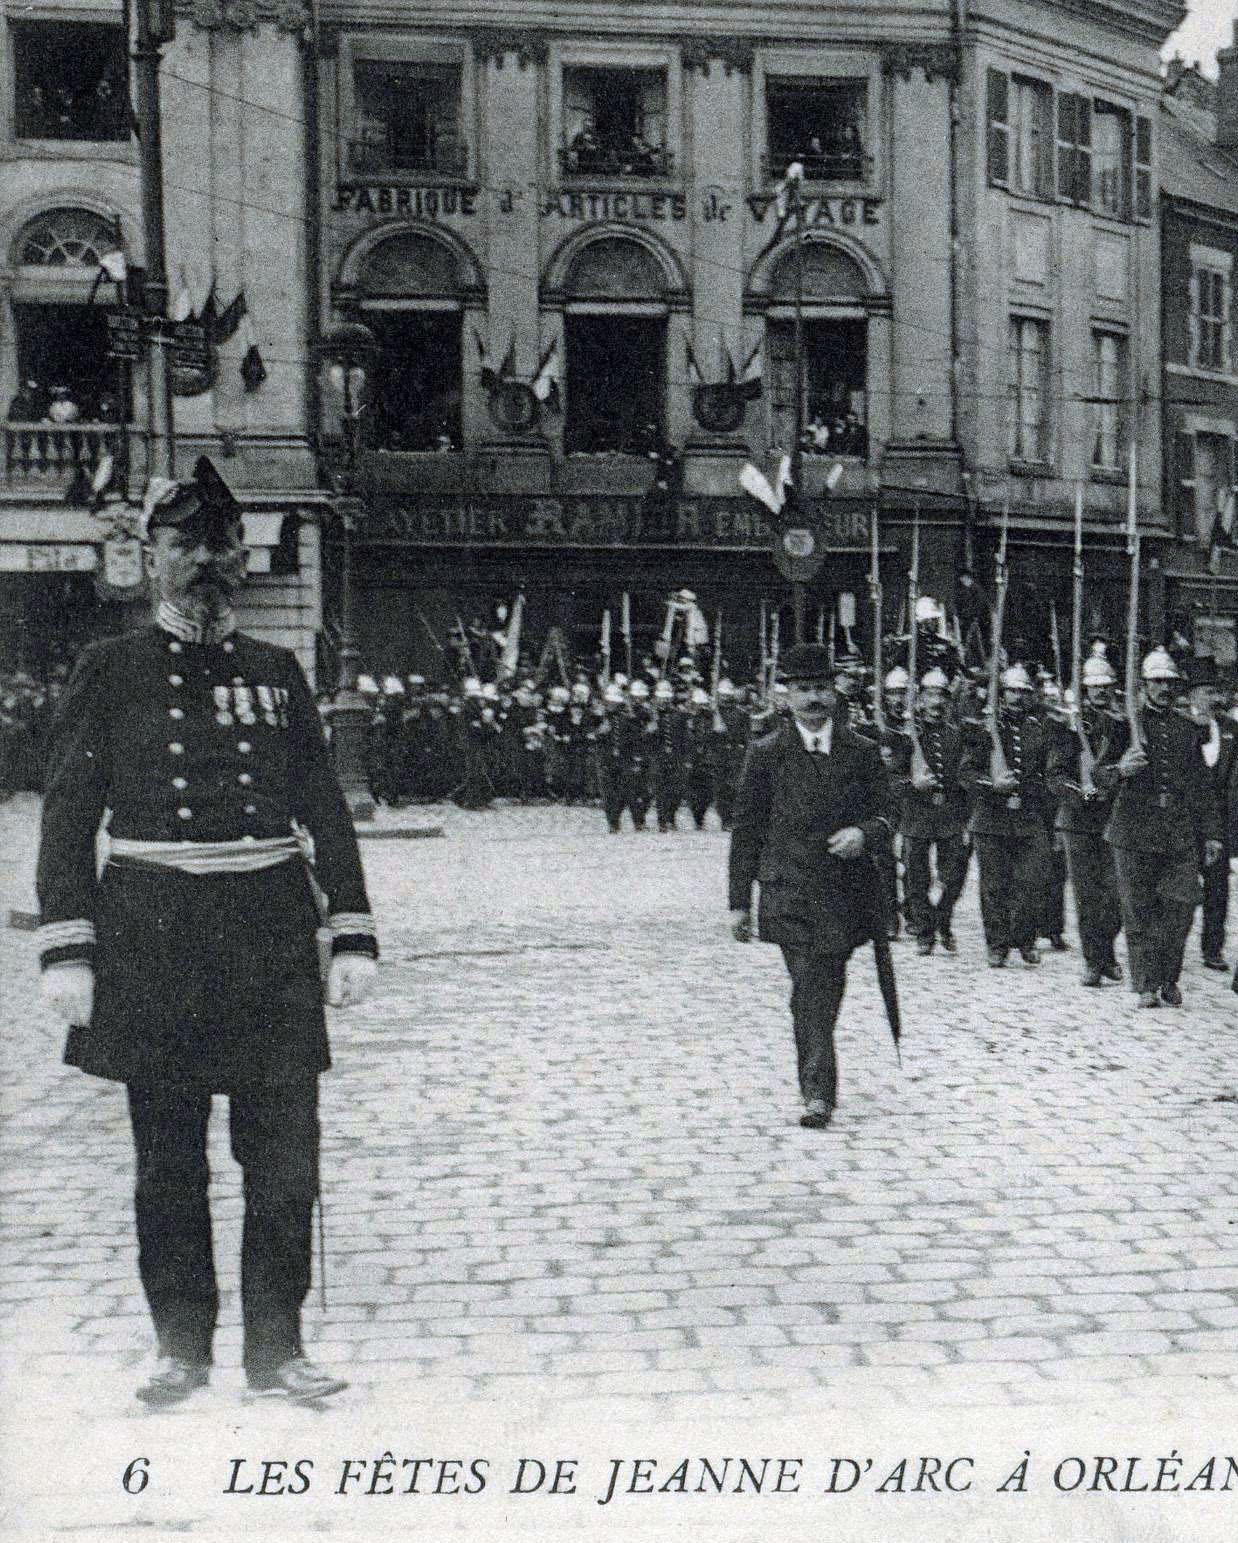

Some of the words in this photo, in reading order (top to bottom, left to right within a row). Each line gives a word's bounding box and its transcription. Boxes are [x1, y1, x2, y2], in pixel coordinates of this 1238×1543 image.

[331, 183, 476, 216] FABRIQUE
[540, 189, 688, 221] ARTICLES
[745, 197, 882, 225] VYAGE
